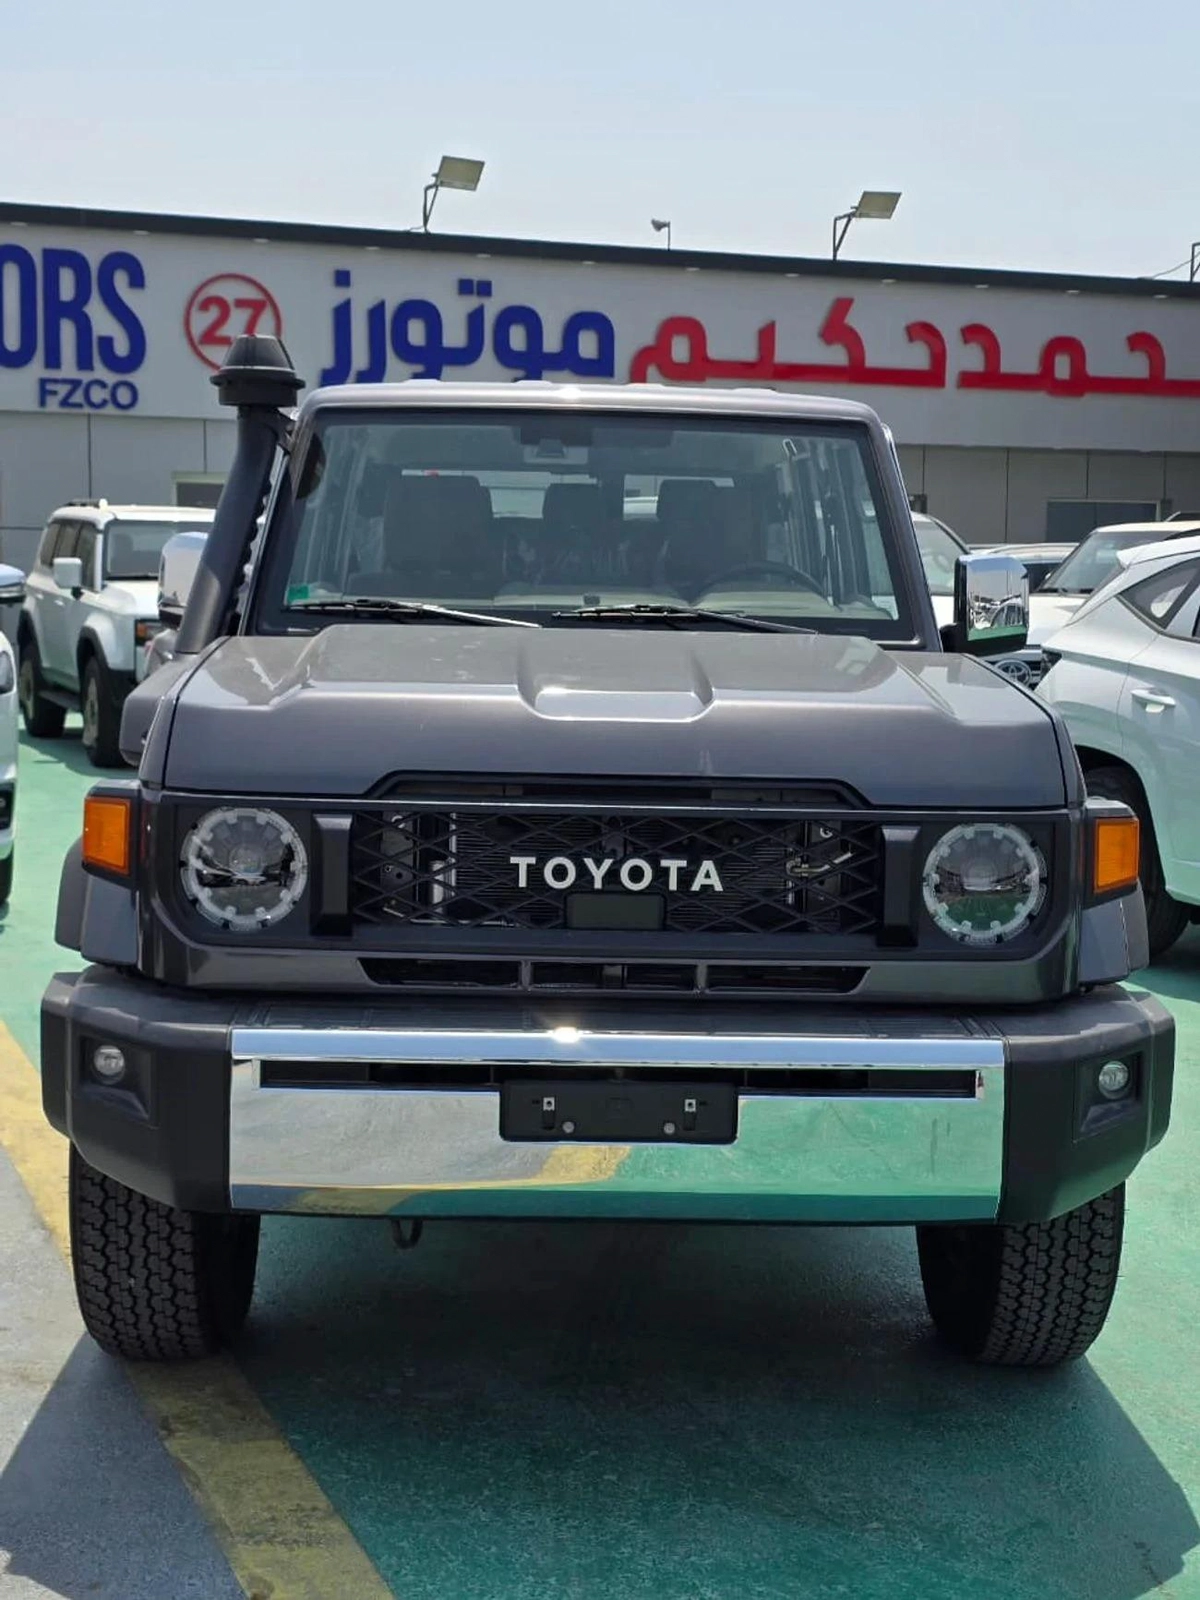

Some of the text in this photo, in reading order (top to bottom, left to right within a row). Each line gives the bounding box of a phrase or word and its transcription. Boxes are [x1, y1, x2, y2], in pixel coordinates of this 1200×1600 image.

[198, 295, 268, 346] 27
[318, 269, 615, 387] موتورز
[38, 377, 139, 410] FZCO
[509, 856, 724, 892] TOYOTA
